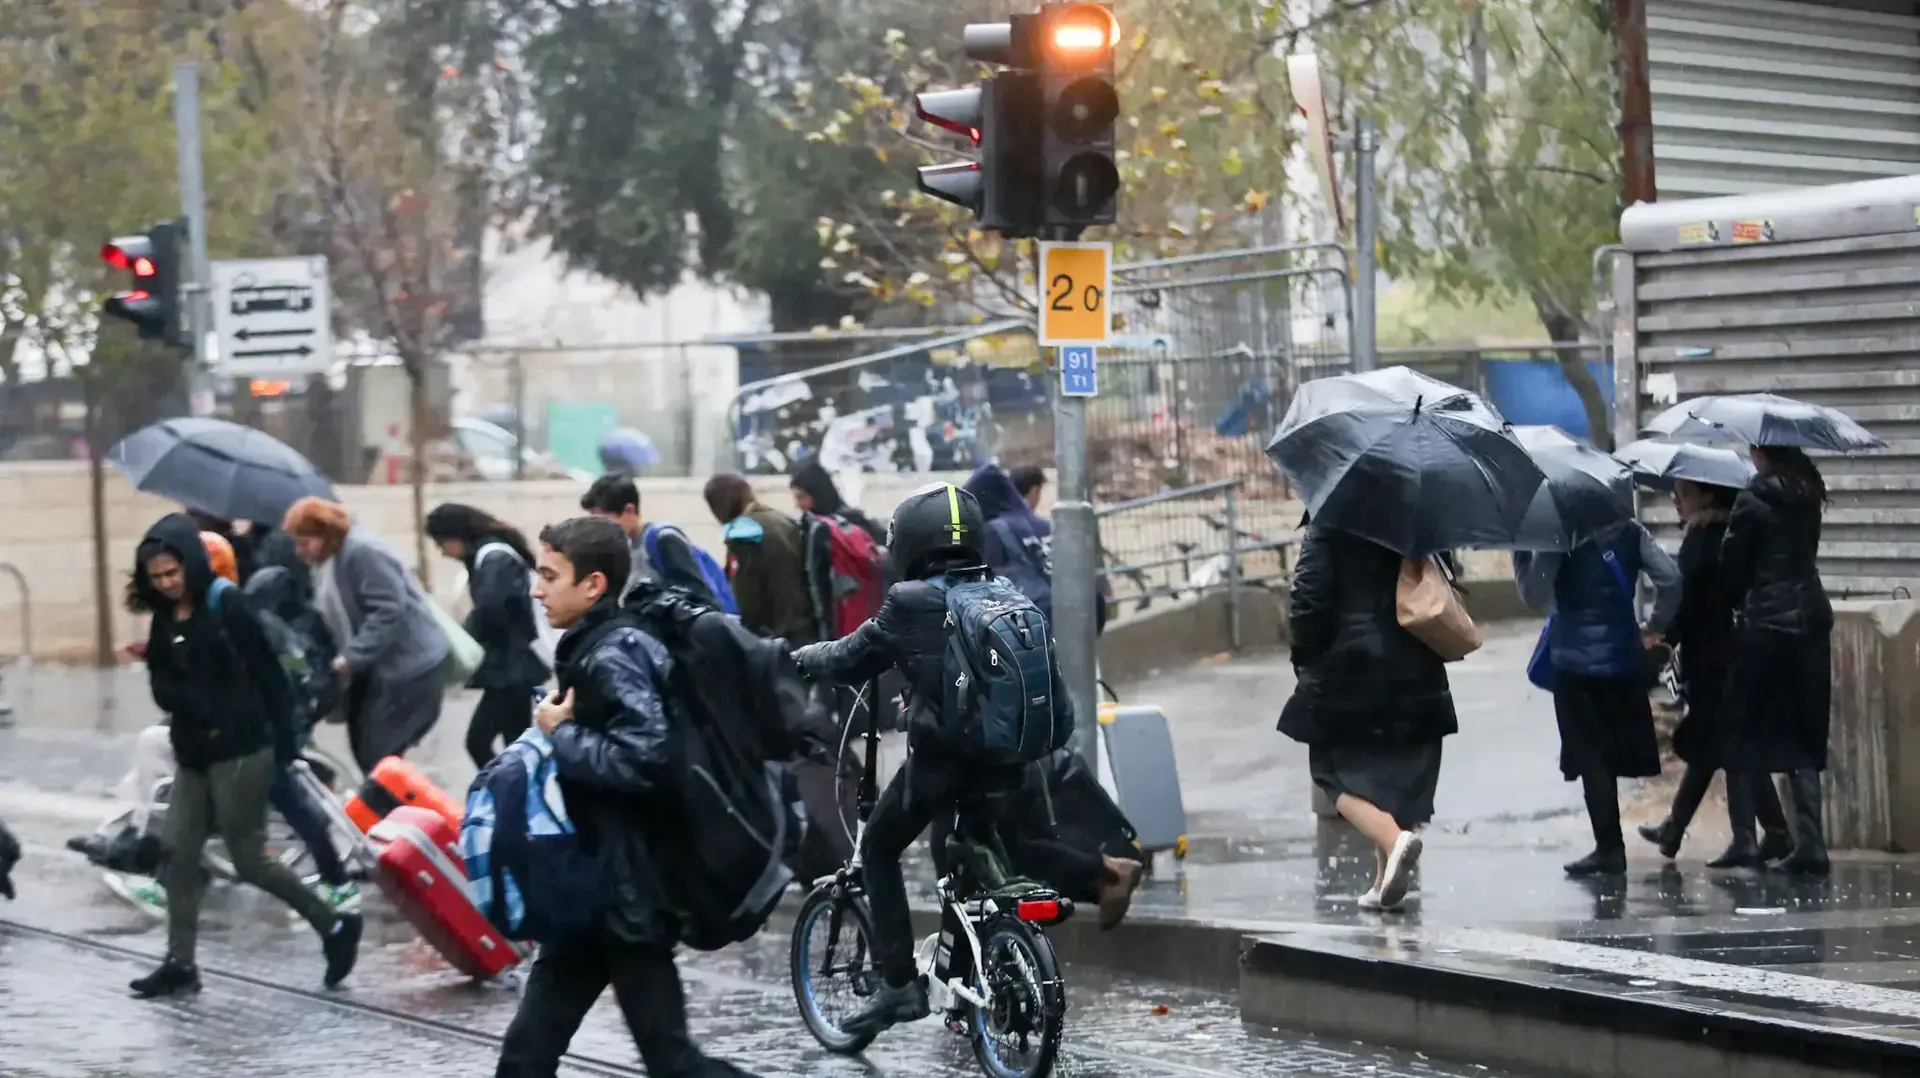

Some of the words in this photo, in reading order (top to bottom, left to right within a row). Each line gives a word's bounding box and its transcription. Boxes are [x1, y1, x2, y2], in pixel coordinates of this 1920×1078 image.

[1051, 273, 1100, 312] 20
[1068, 352, 1088, 369] 91
[1072, 374, 1088, 387] T1
